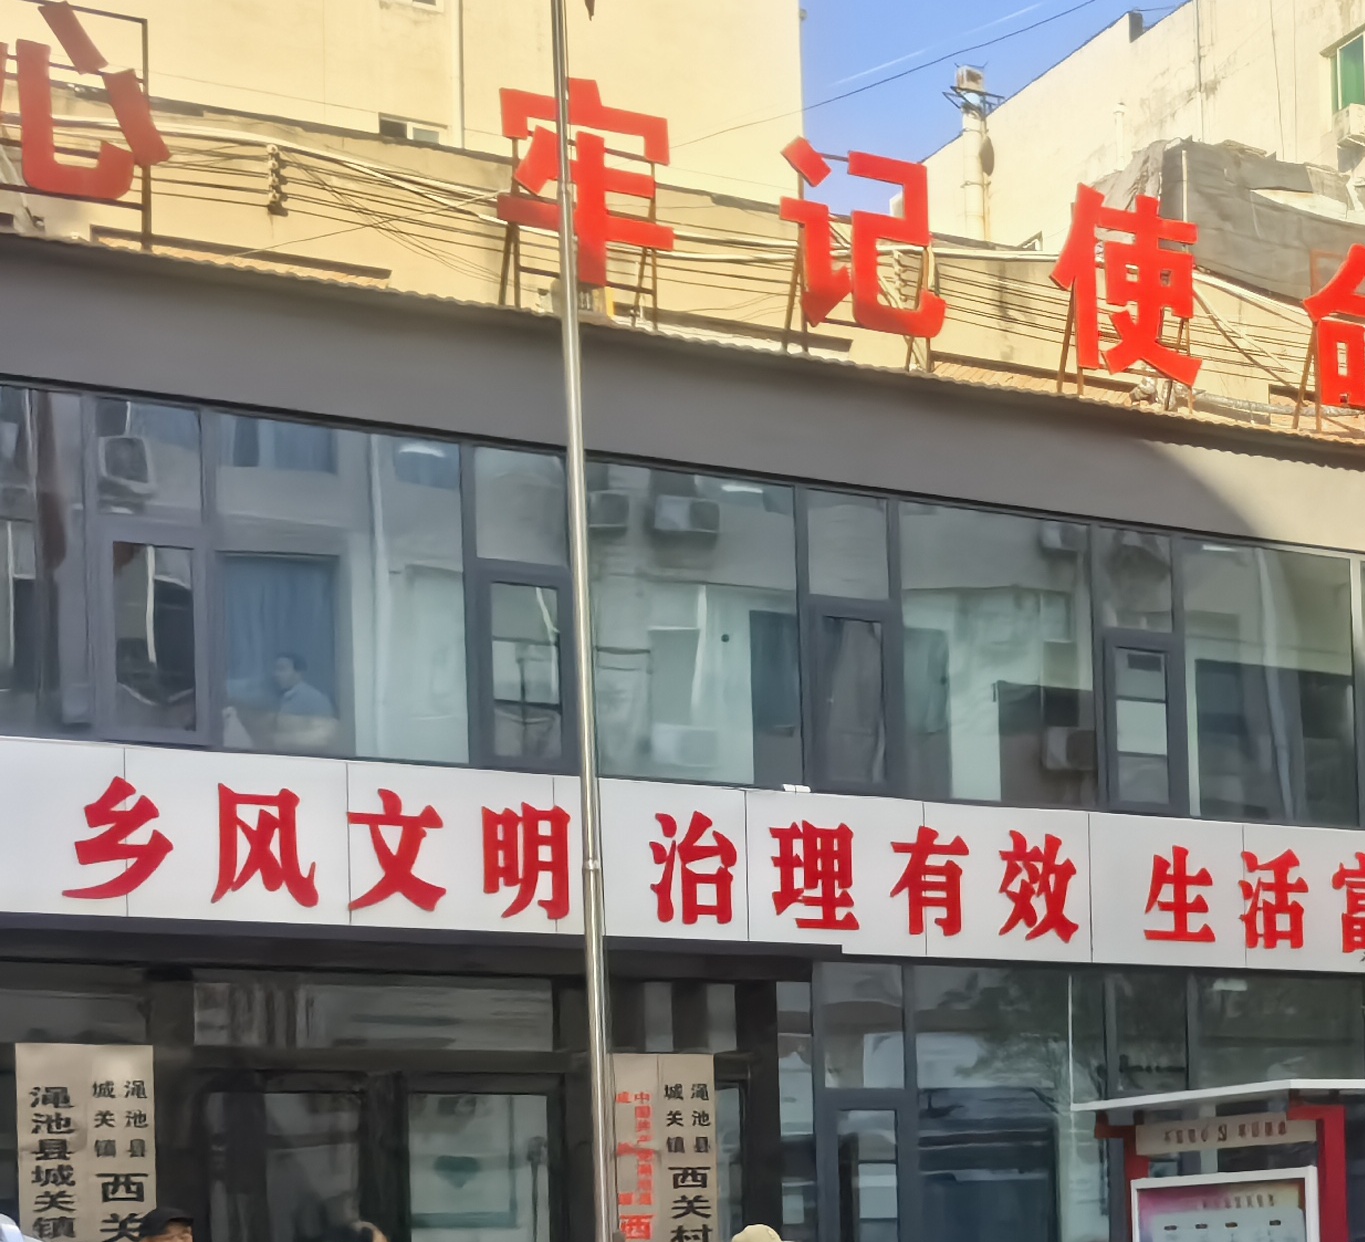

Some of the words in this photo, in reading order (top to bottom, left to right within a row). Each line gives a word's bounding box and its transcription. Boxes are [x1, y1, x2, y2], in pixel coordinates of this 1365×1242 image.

[0, 1, 171, 200] 心
[62, 776, 572, 920] 乡风文明
[649, 811, 1080, 944] 治理有效
